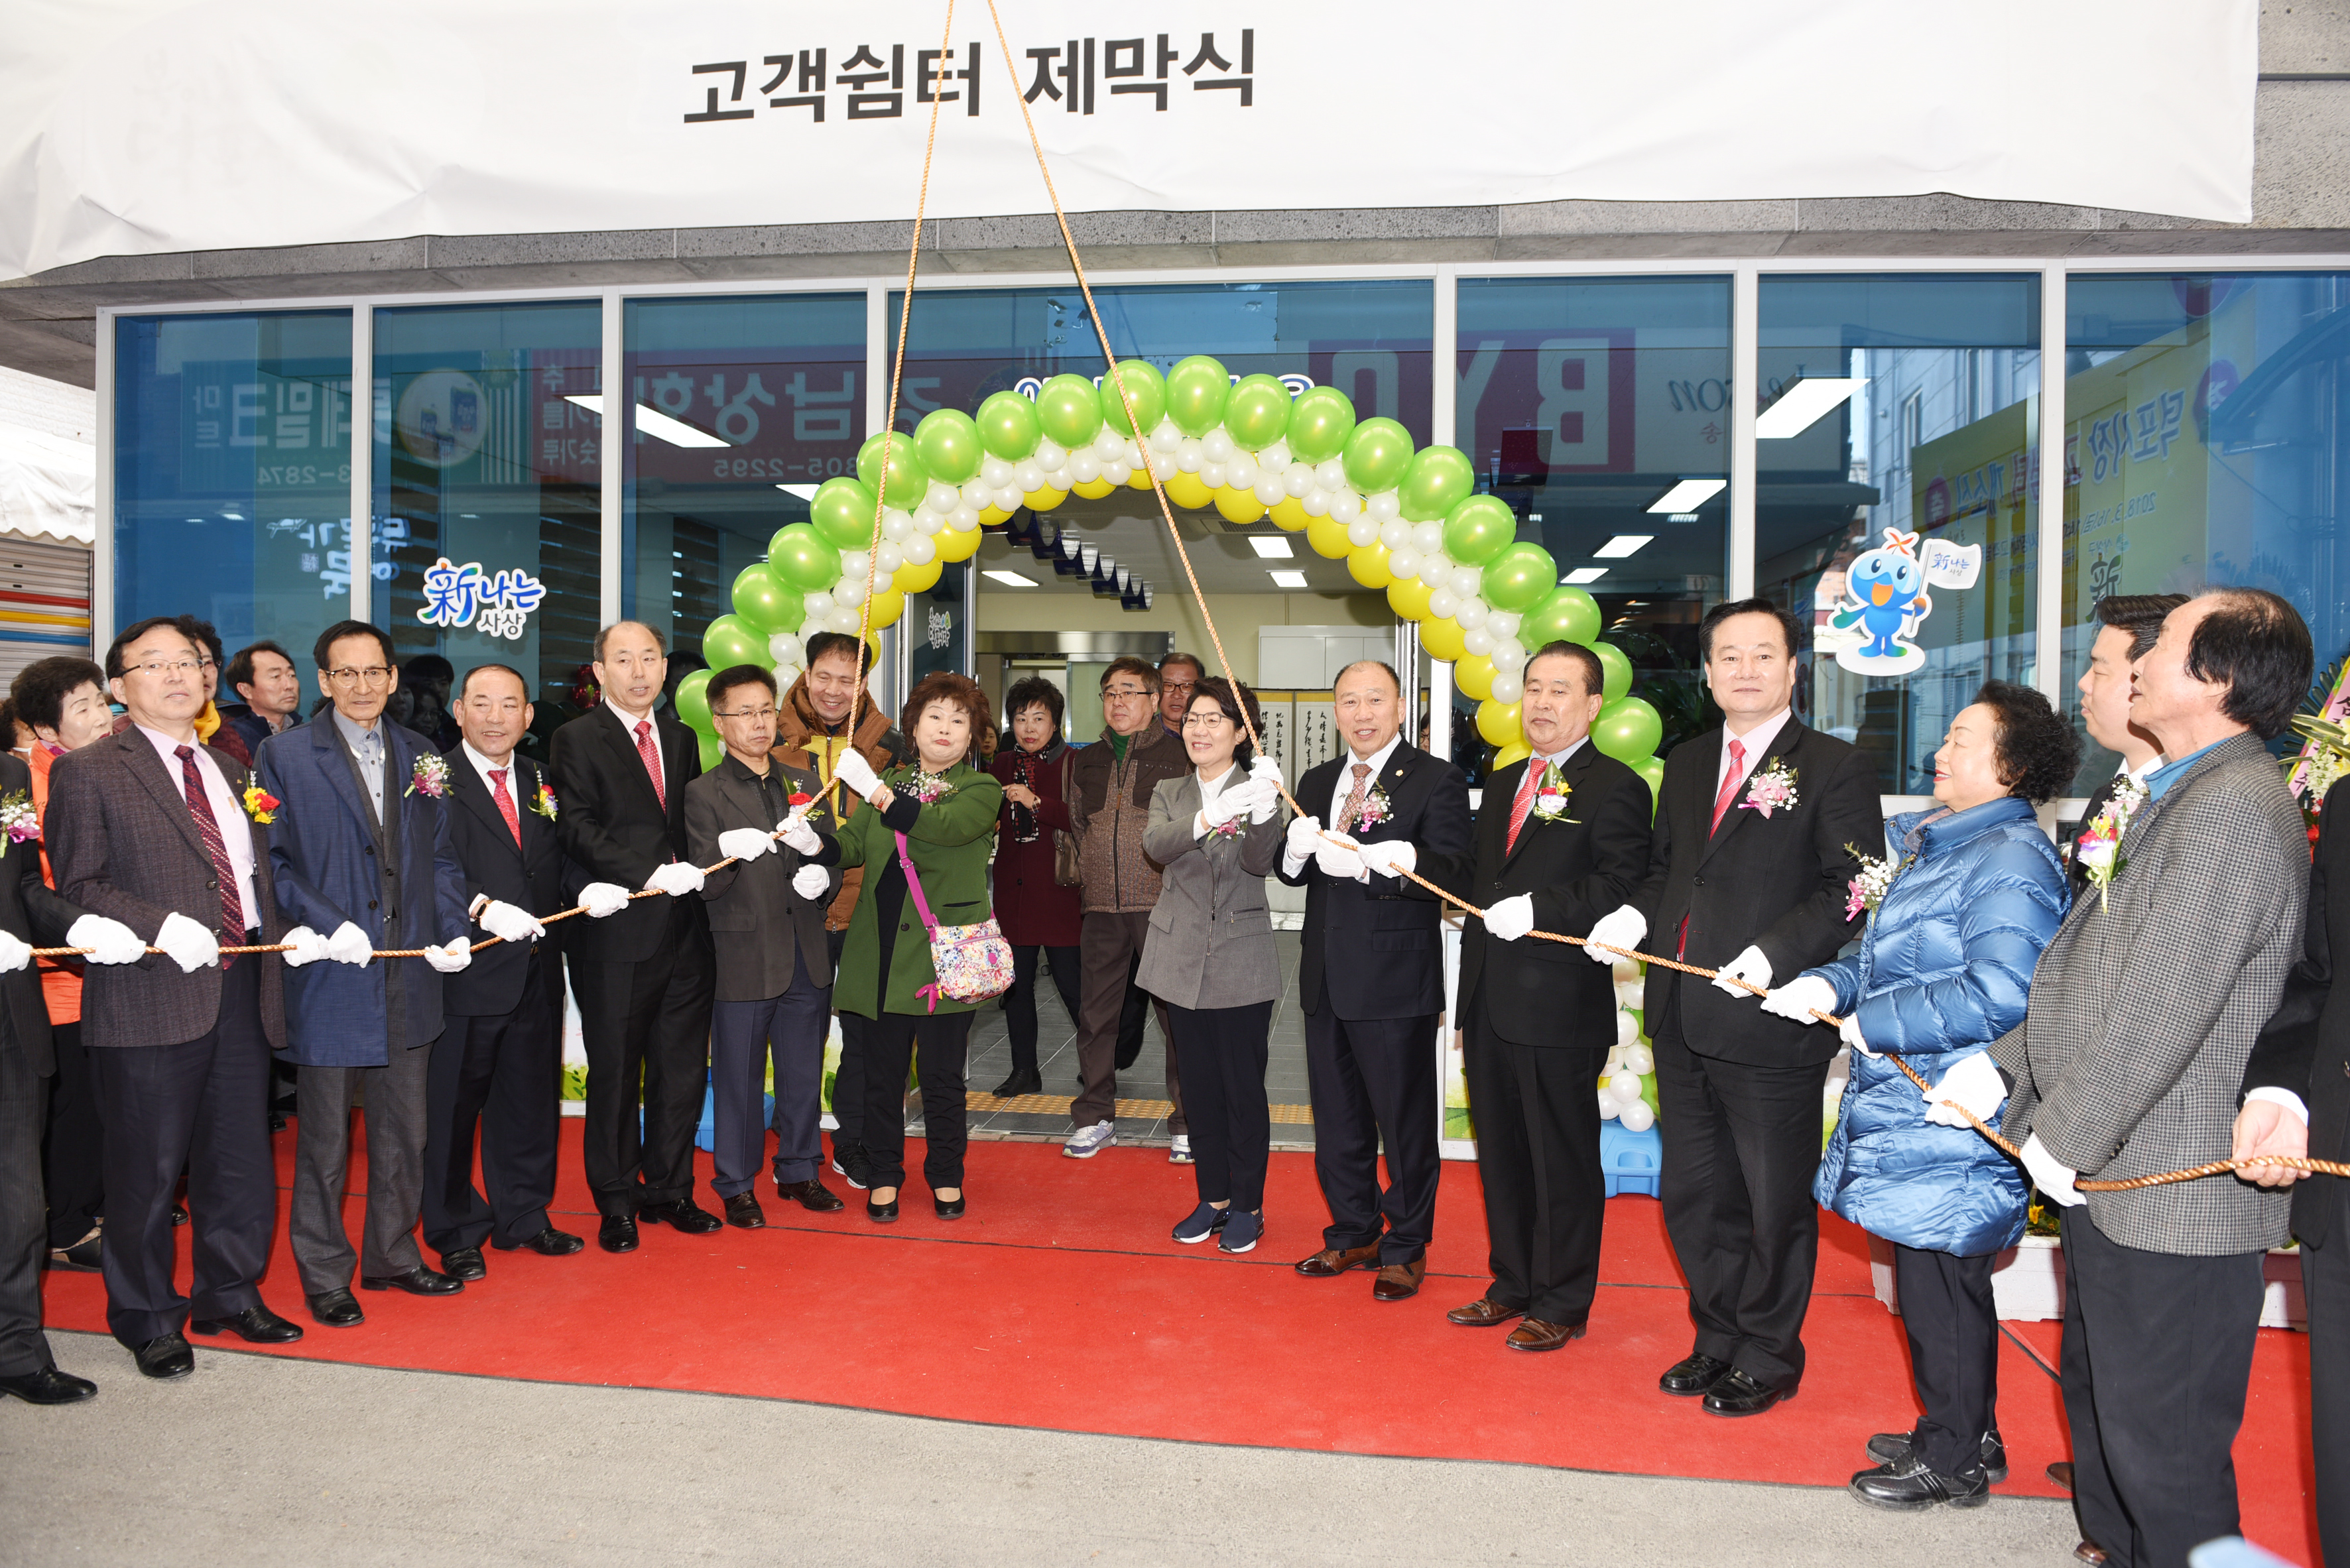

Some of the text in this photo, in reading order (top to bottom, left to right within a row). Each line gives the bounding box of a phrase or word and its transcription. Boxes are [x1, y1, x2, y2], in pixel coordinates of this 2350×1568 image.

[684, 29, 1254, 123] 고객쉼터 제막식
[1931, 552, 1970, 570] 新나는
[420, 562, 542, 622] 新나는
[480, 613, 524, 636] 사상
